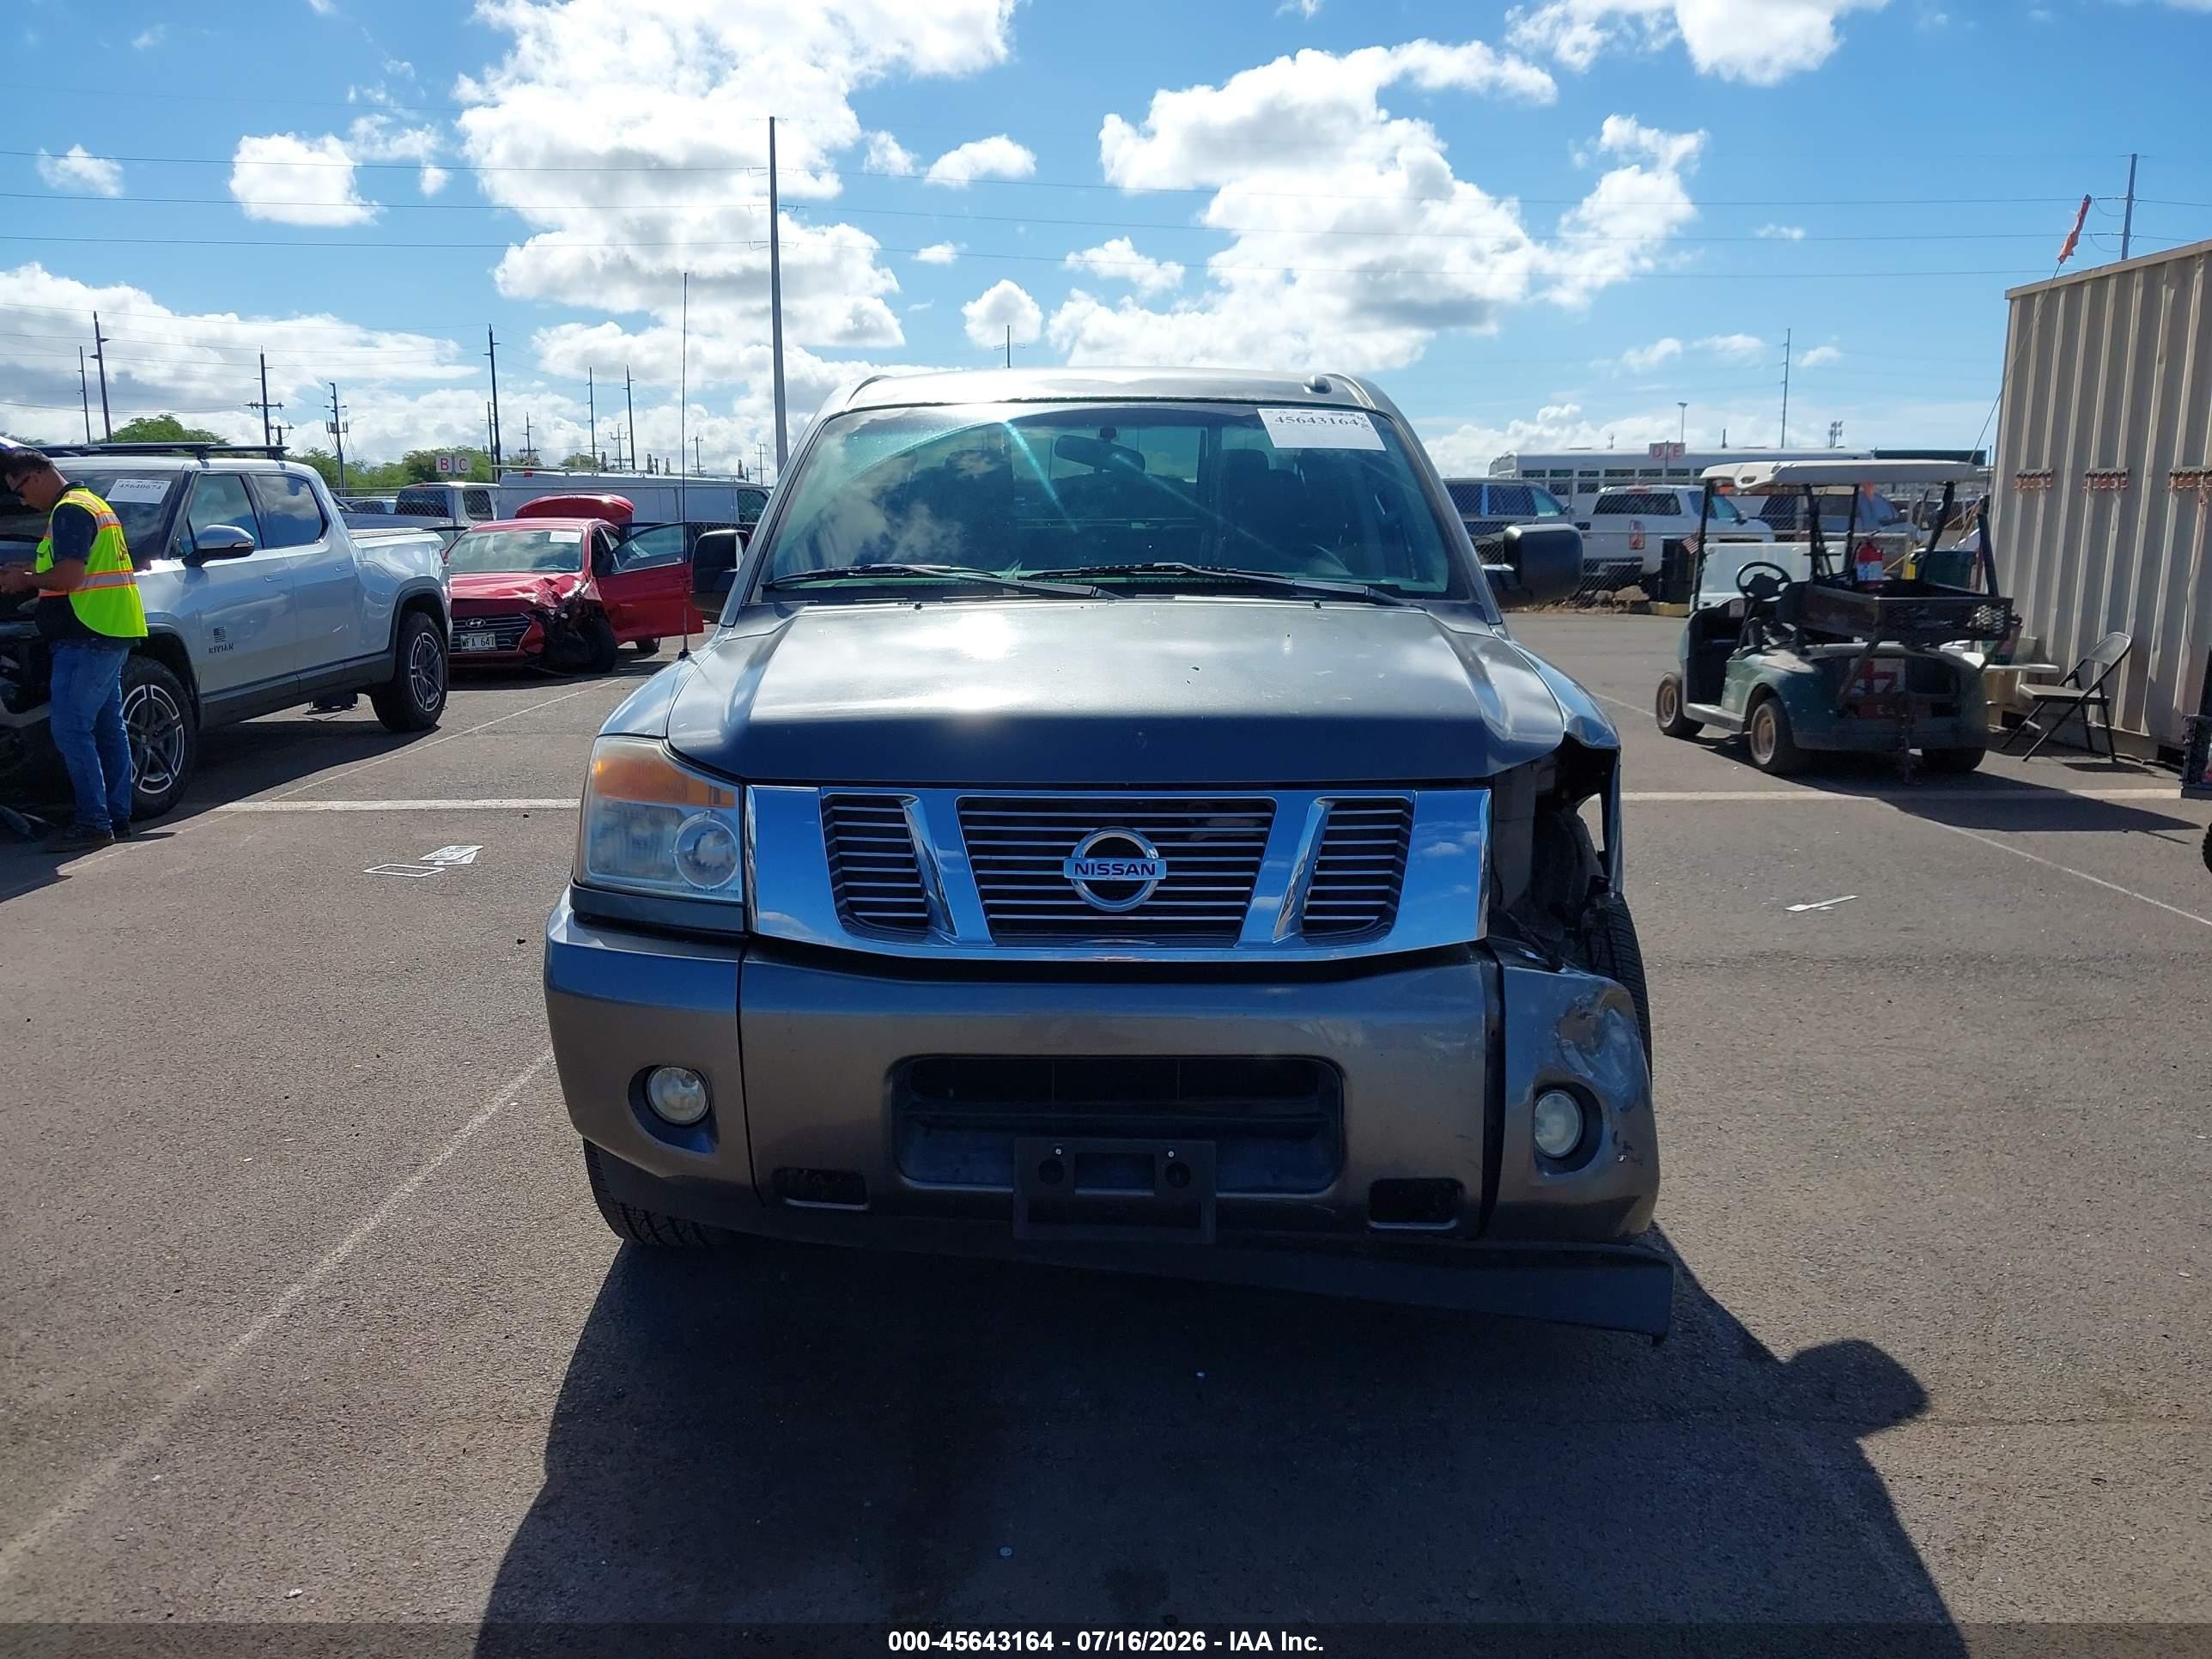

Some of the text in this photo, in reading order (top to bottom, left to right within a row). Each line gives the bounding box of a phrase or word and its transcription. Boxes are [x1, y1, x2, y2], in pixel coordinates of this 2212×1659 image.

[1274, 416, 1359, 426] 45643164
[1673, 444, 1682, 458] E
[440, 458, 468, 471] B C
[1074, 862, 1156, 876] NISSAN
